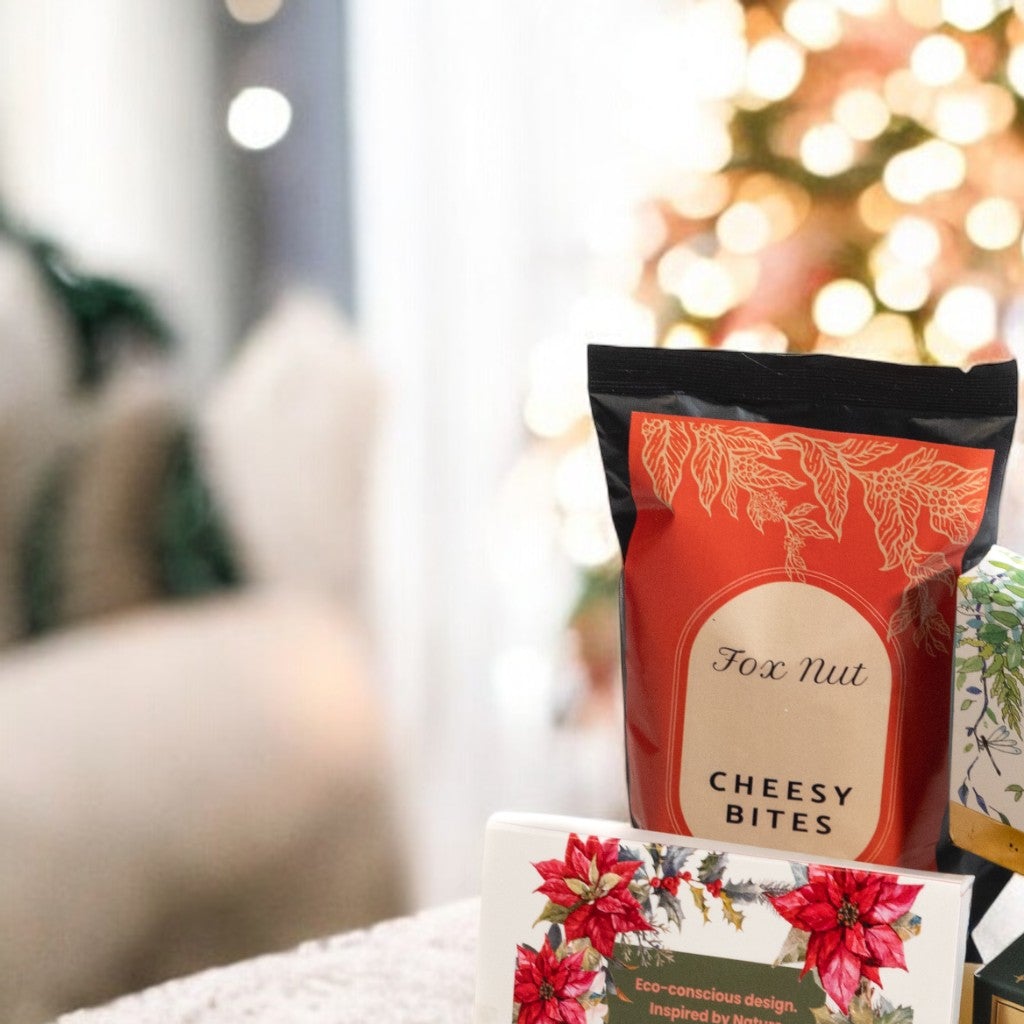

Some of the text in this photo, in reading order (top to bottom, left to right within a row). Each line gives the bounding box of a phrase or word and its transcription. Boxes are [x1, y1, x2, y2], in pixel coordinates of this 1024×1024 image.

[712, 646, 868, 687] Fox Nut
[709, 771, 853, 806] CHEESY
[726, 804, 832, 836] BITES
[635, 977, 797, 1015] Eco-conscious design.
[650, 1002, 709, 1022] Inspired
